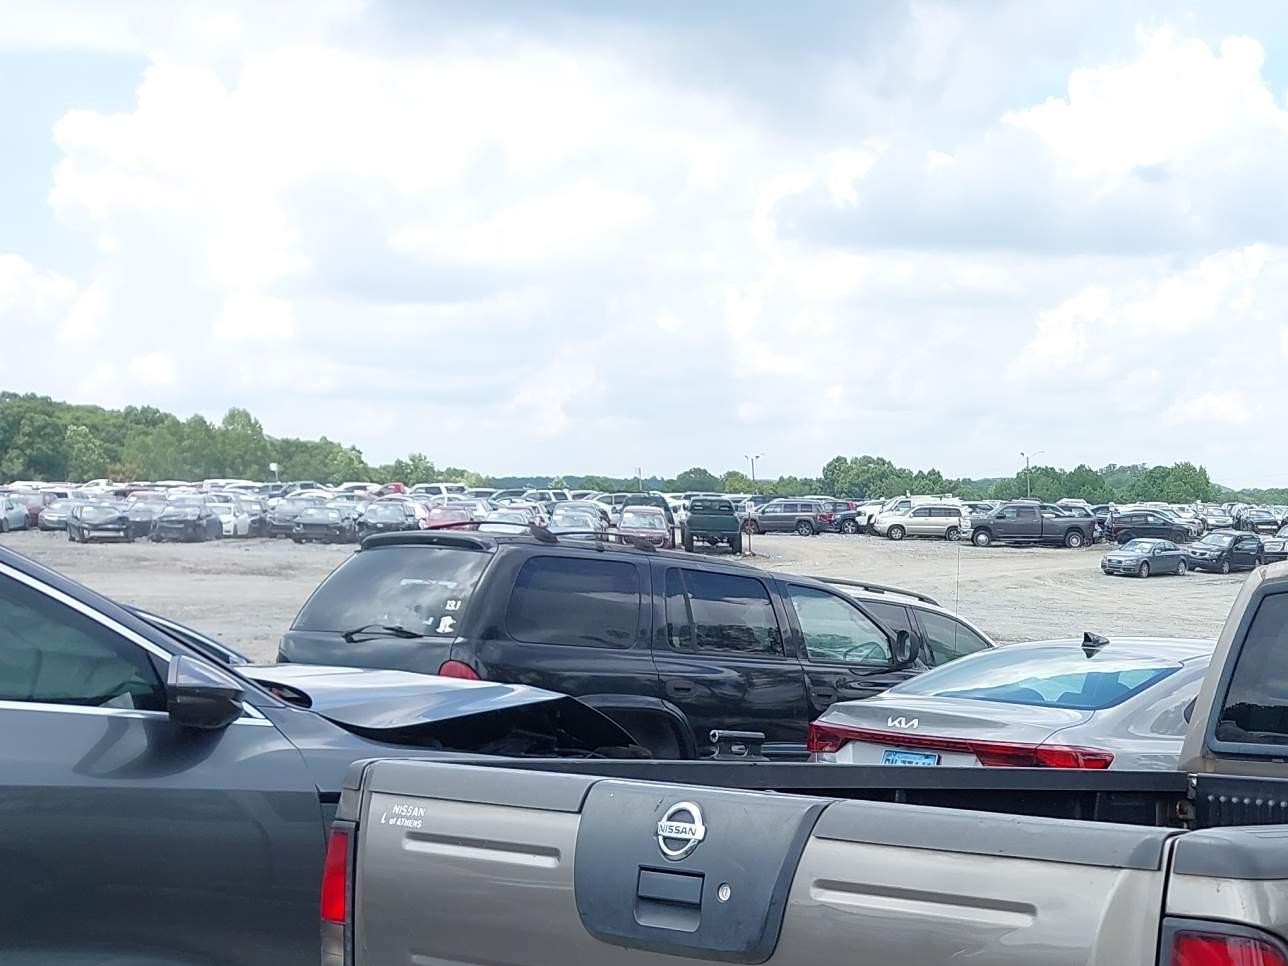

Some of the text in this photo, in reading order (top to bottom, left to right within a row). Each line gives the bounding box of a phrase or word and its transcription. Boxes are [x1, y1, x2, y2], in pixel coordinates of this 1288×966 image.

[887, 716, 919, 729] KIA
[392, 804, 426, 817] NISSAN
[658, 824, 697, 837] NISSAN
